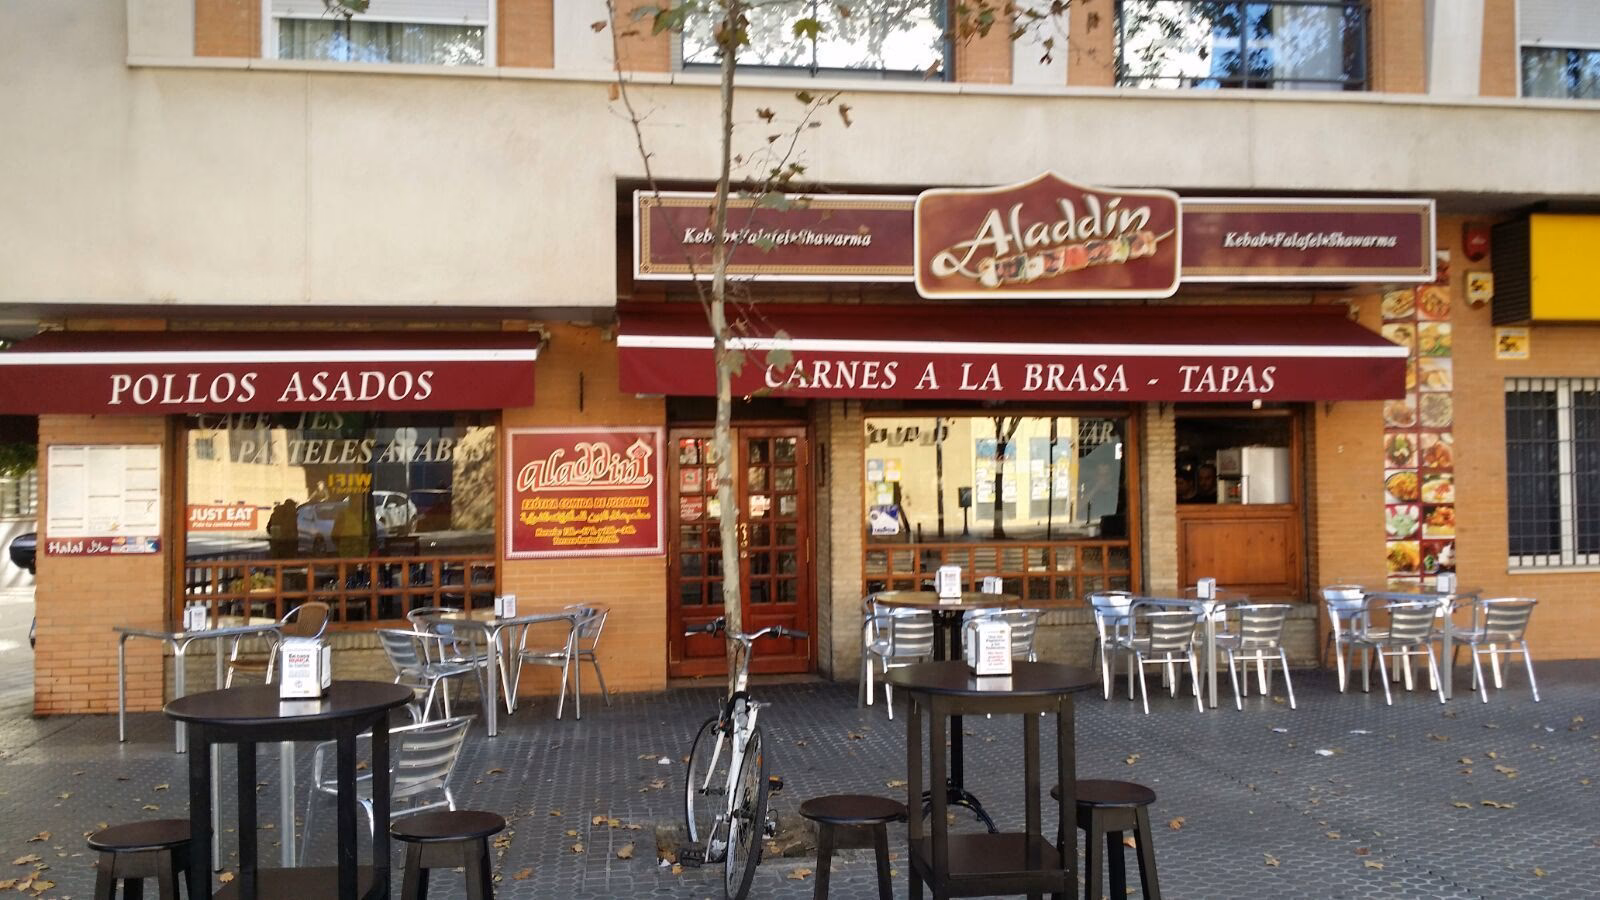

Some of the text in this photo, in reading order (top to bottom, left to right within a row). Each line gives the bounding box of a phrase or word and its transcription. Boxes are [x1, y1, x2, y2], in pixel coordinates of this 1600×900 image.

[682, 227, 731, 244] Kebb
[931, 194, 1151, 278] Aladdin
[107, 370, 434, 405] POLLOS ASADOS
[765, 359, 899, 390] CARNES
[914, 361, 940, 390] A
[958, 362, 1004, 391] LA
[1022, 363, 1129, 392] BRASA
[1178, 365, 1277, 393] TAPAS
[237, 438, 376, 465] PATELES
[516, 441, 654, 492] aladdin
[189, 507, 255, 521] JUST EAT
[47, 540, 84, 555] Halal
